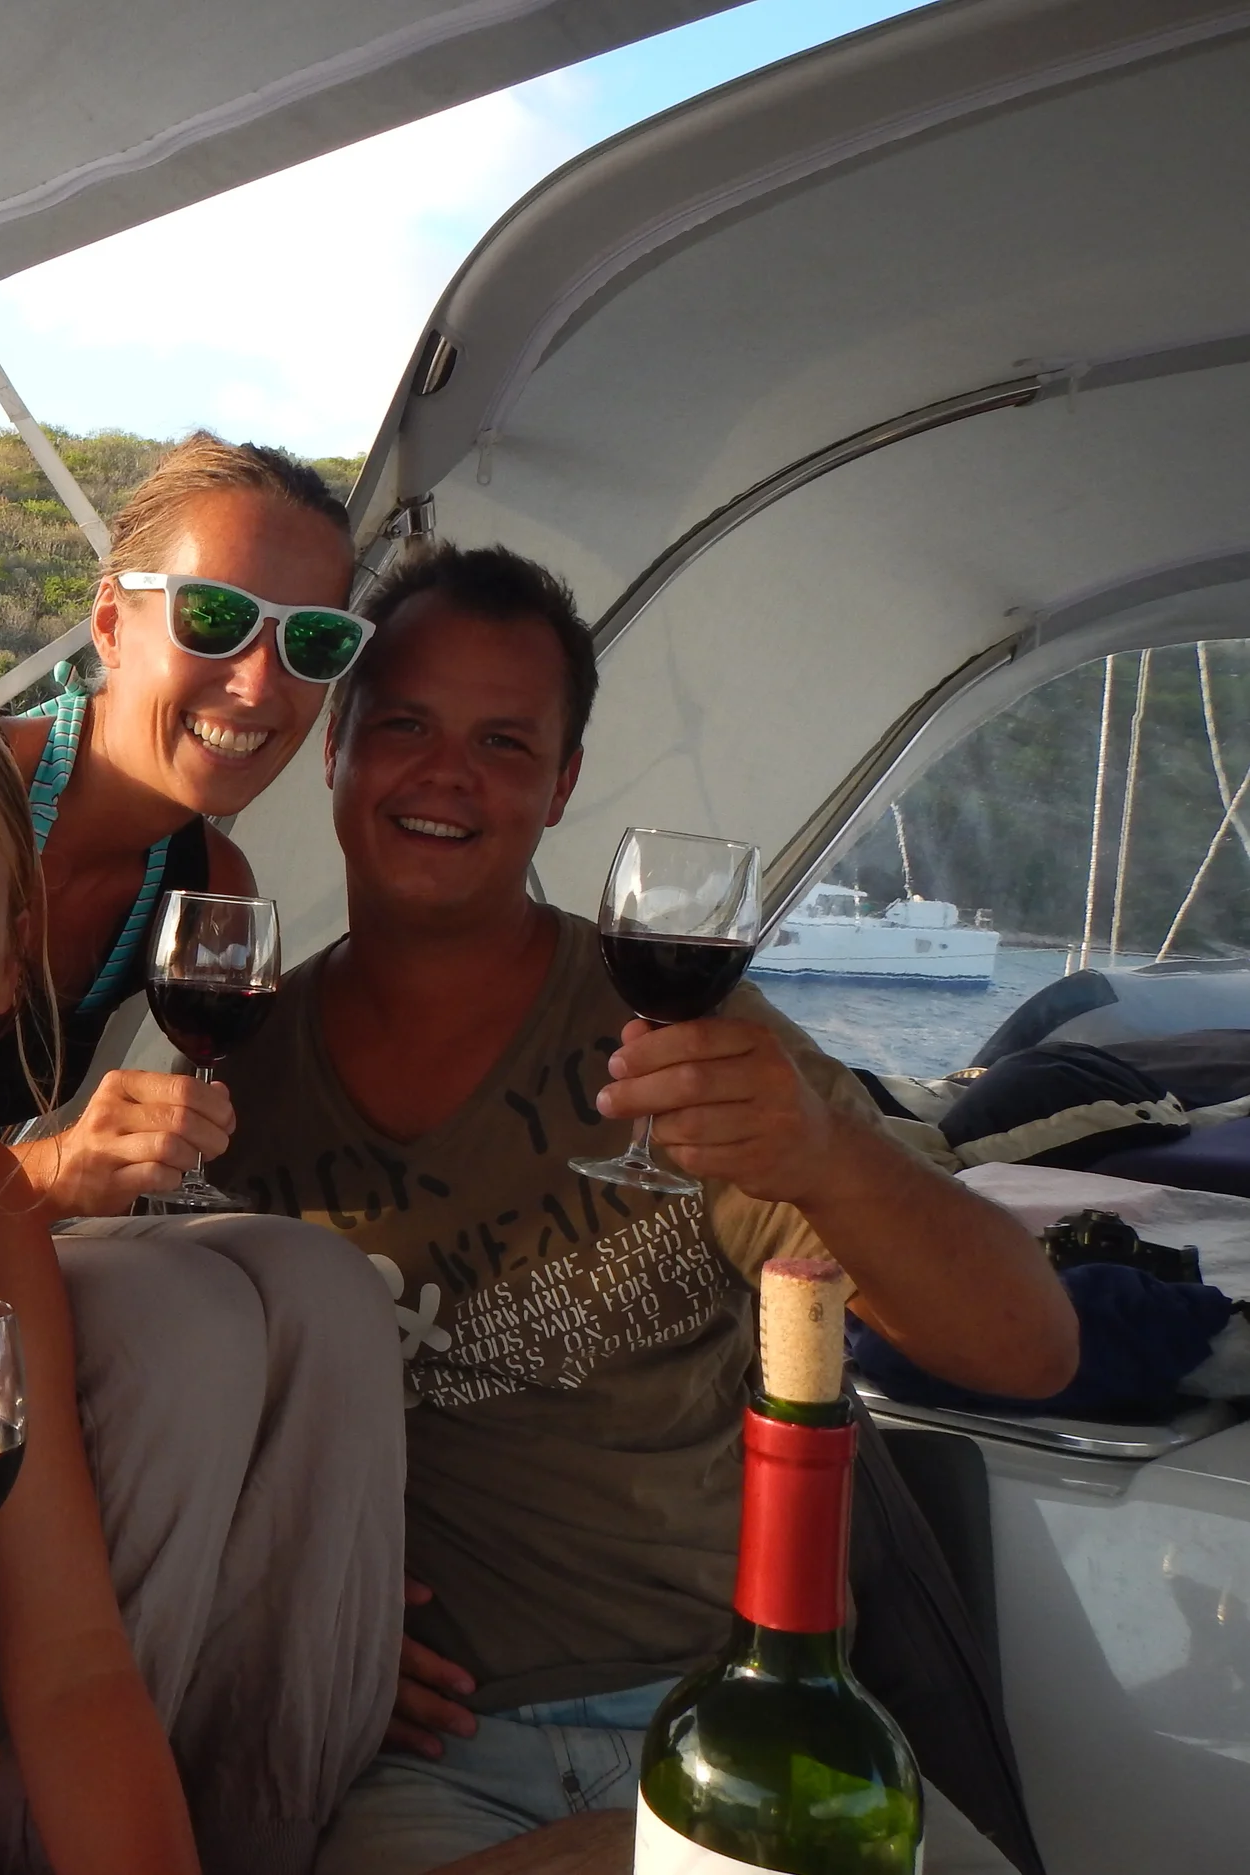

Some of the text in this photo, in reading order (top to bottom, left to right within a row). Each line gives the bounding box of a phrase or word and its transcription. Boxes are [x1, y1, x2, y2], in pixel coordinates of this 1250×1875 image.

[506, 1037, 619, 1154] YO
[454, 1192, 703, 1320] THIS ARE STRAIG
[590, 1230, 682, 1291] FITTED
[448, 1329, 524, 1366] GOODS
[531, 1299, 599, 1342] MADE
[602, 1273, 652, 1311] FOR
[563, 1322, 603, 1353] ON
[621, 1293, 660, 1325] TO
